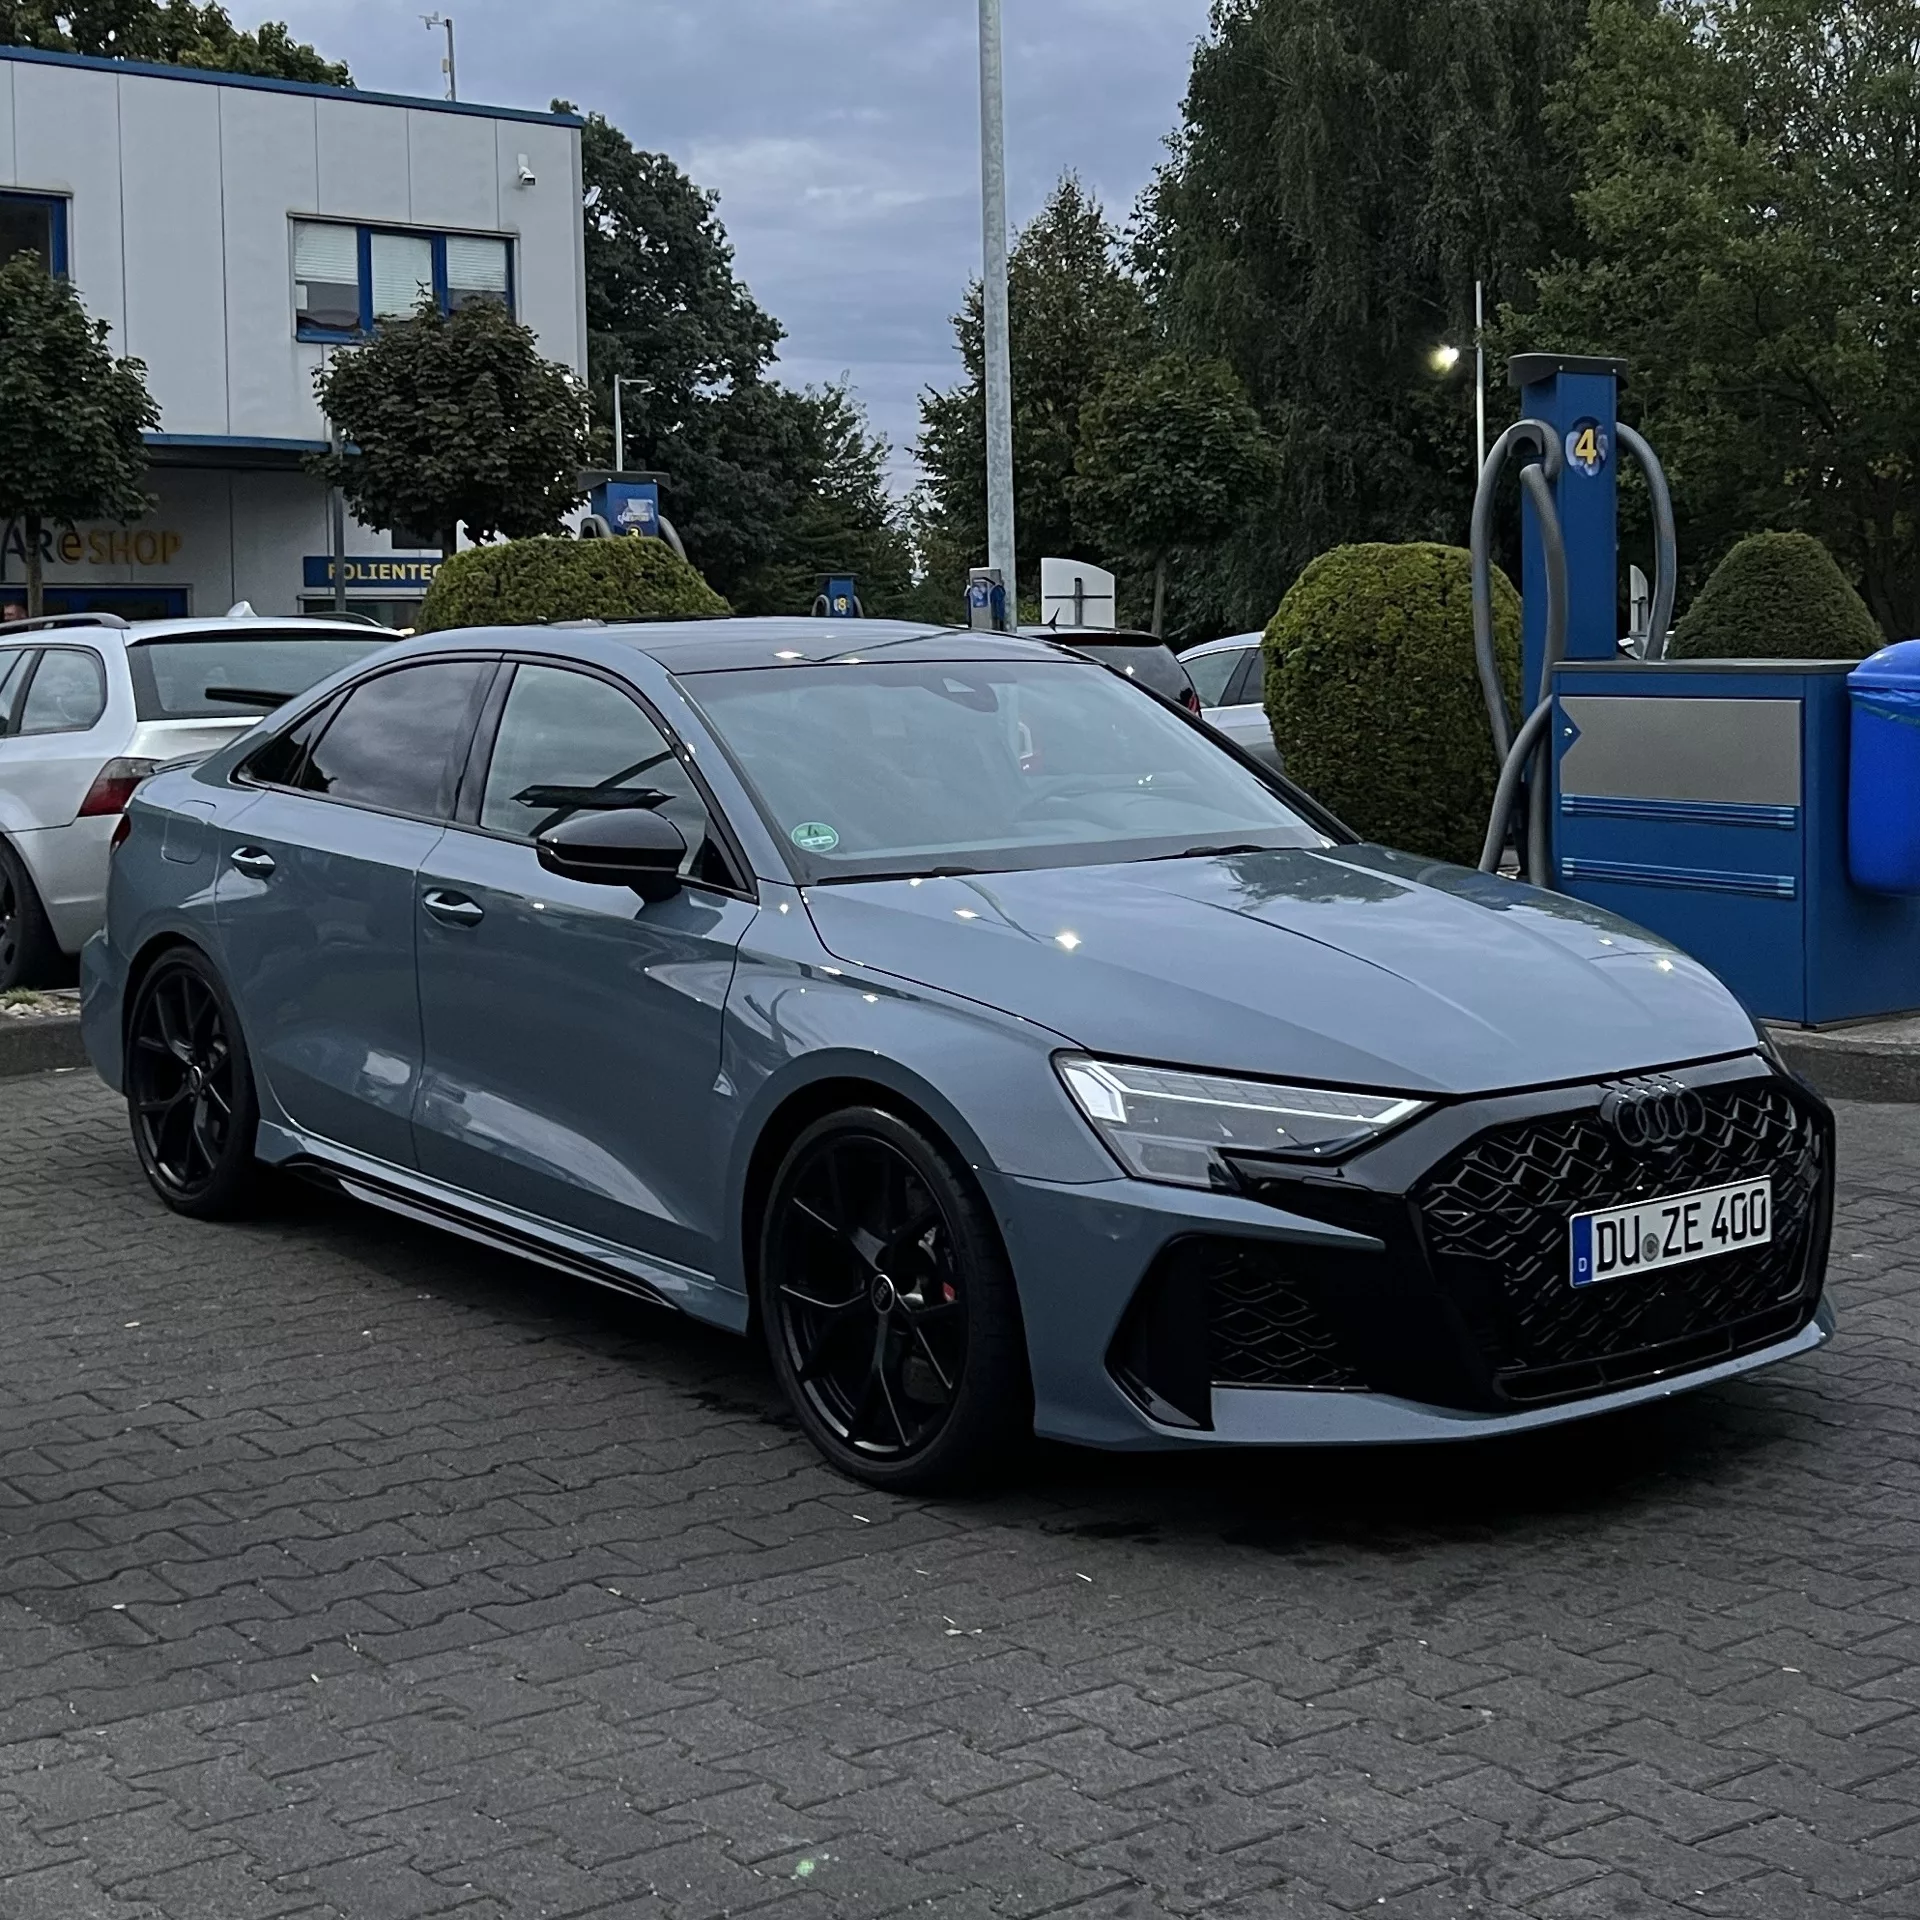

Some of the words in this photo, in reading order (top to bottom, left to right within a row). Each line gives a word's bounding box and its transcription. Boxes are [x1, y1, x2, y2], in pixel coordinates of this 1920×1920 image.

[1574, 428, 1597, 465] 4
[1596, 1214, 1641, 1273] DU
[1661, 1201, 1704, 1259] ZE
[1711, 1187, 1767, 1245] 400
[1577, 1257, 1588, 1273] D
